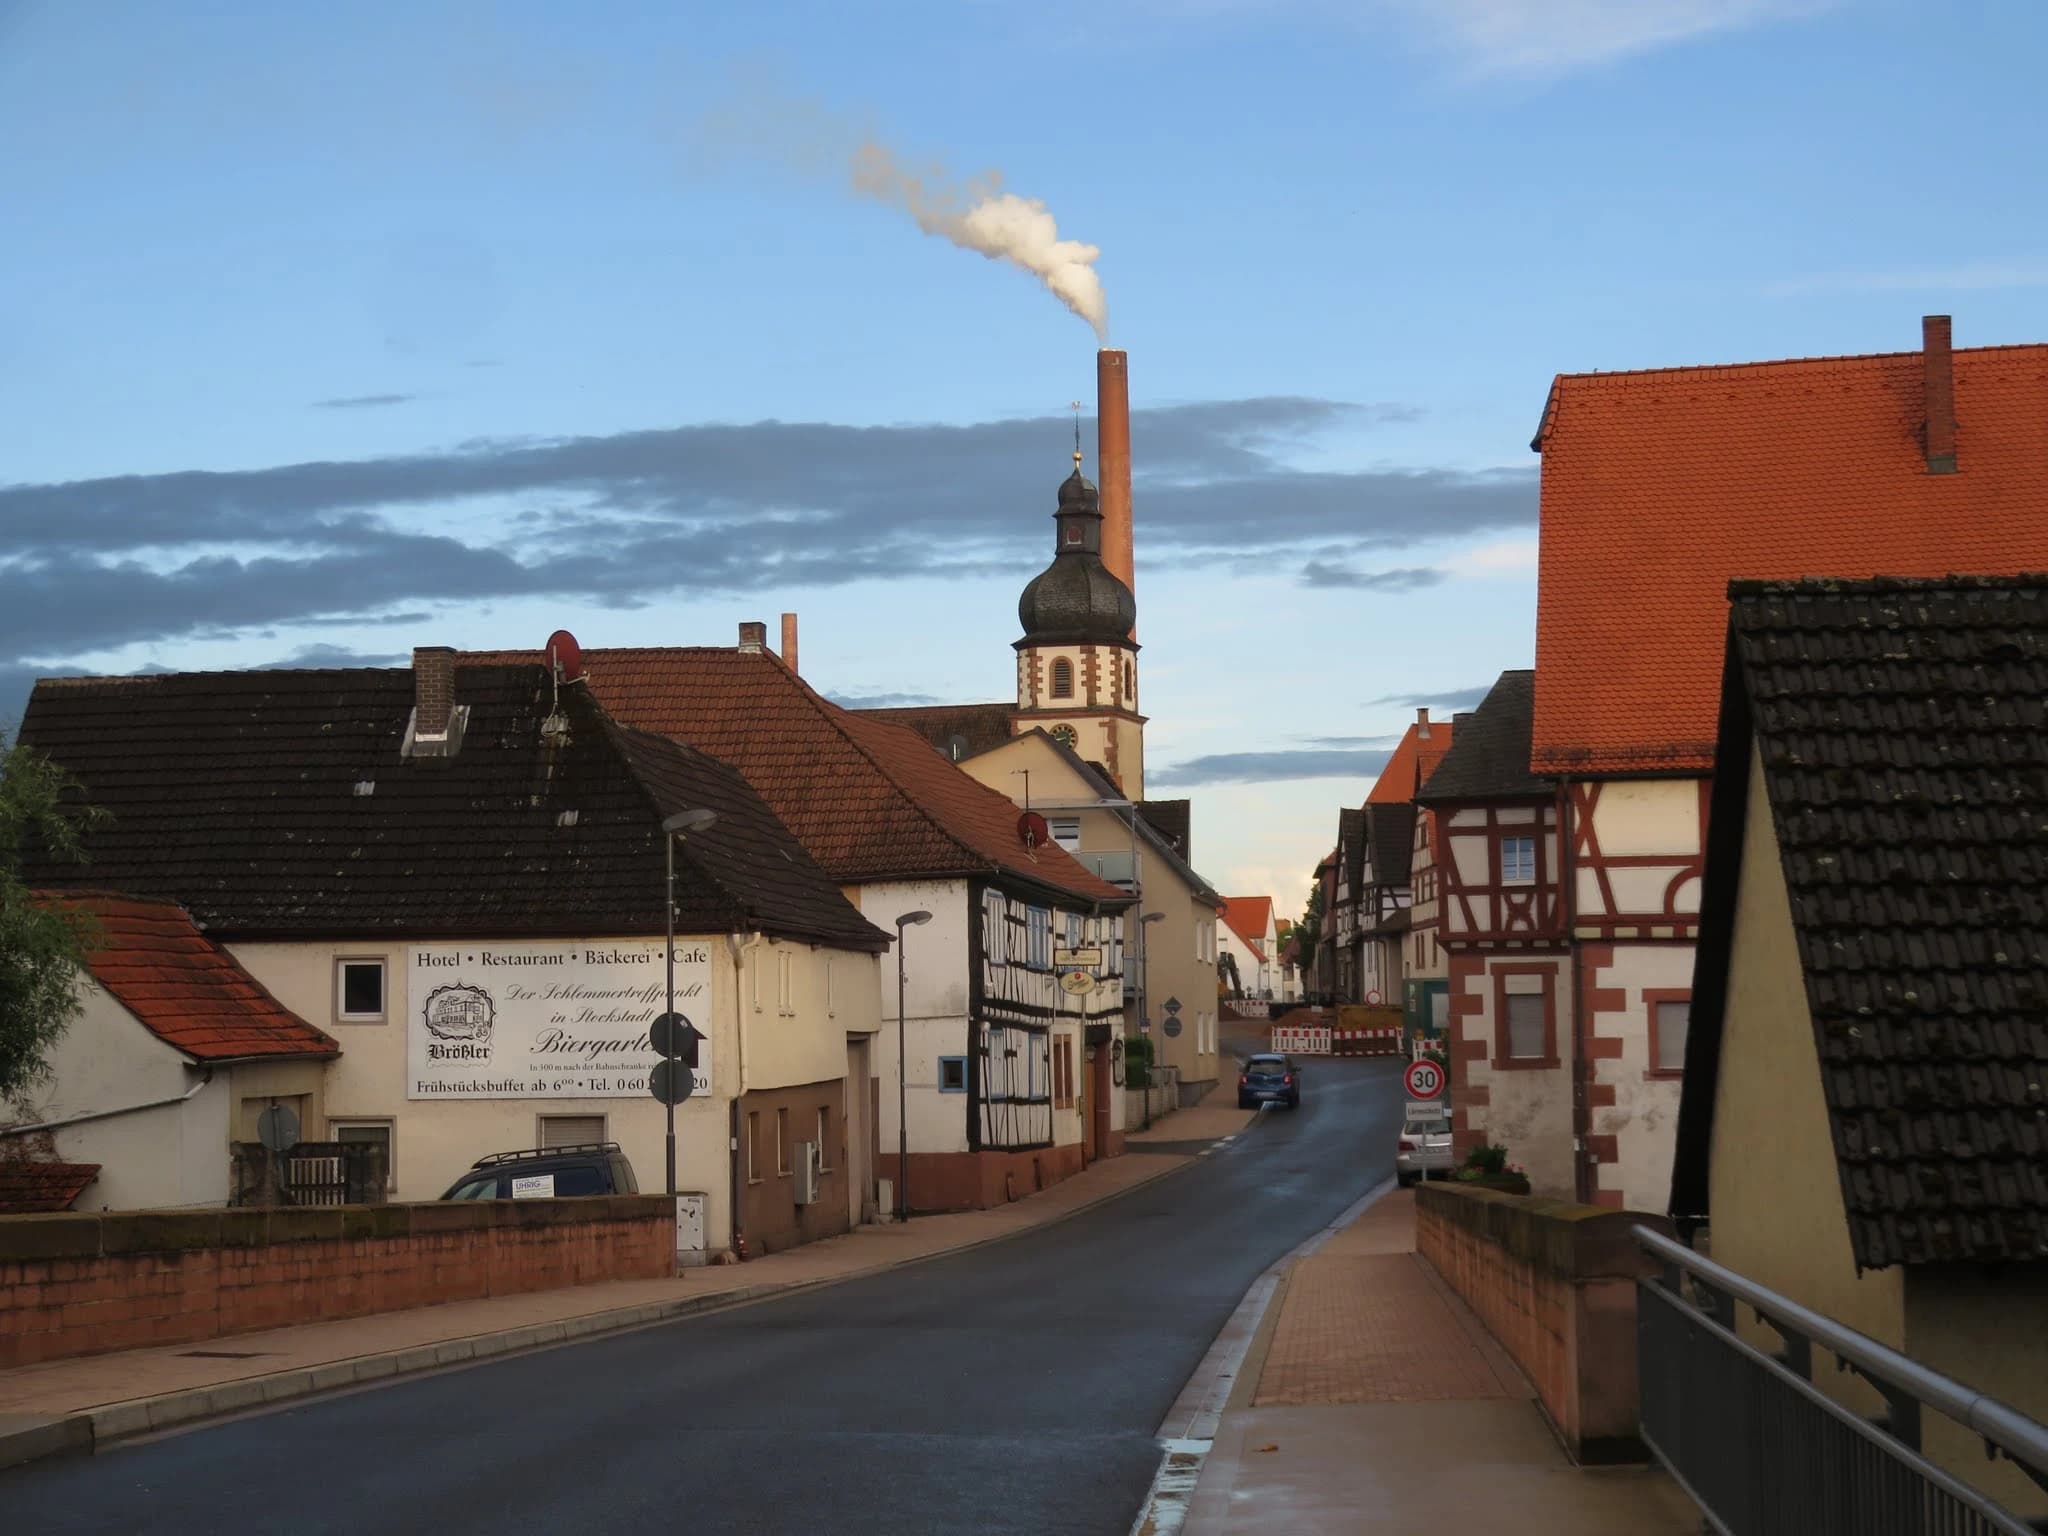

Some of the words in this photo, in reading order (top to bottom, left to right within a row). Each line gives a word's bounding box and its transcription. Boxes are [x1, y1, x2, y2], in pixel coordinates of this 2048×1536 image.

[417, 951, 460, 967] Hotel
[481, 951, 564, 966] Restaurant
[585, 949, 650, 965] Bäckerei
[672, 948, 707, 964] Cafe
[504, 983, 536, 1001] Der
[550, 1011, 566, 1024] in
[570, 1006, 654, 1024] Stockstadt
[428, 1044, 490, 1060] Brößler
[530, 1027, 656, 1061] Biergarte
[563, 1063, 581, 1071] nach
[582, 1062, 594, 1071] der
[417, 1079, 525, 1093] Frühstücksbuffet
[531, 1079, 547, 1092] ab
[587, 1077, 611, 1091] Tel.
[1413, 1071, 1436, 1088] 30
